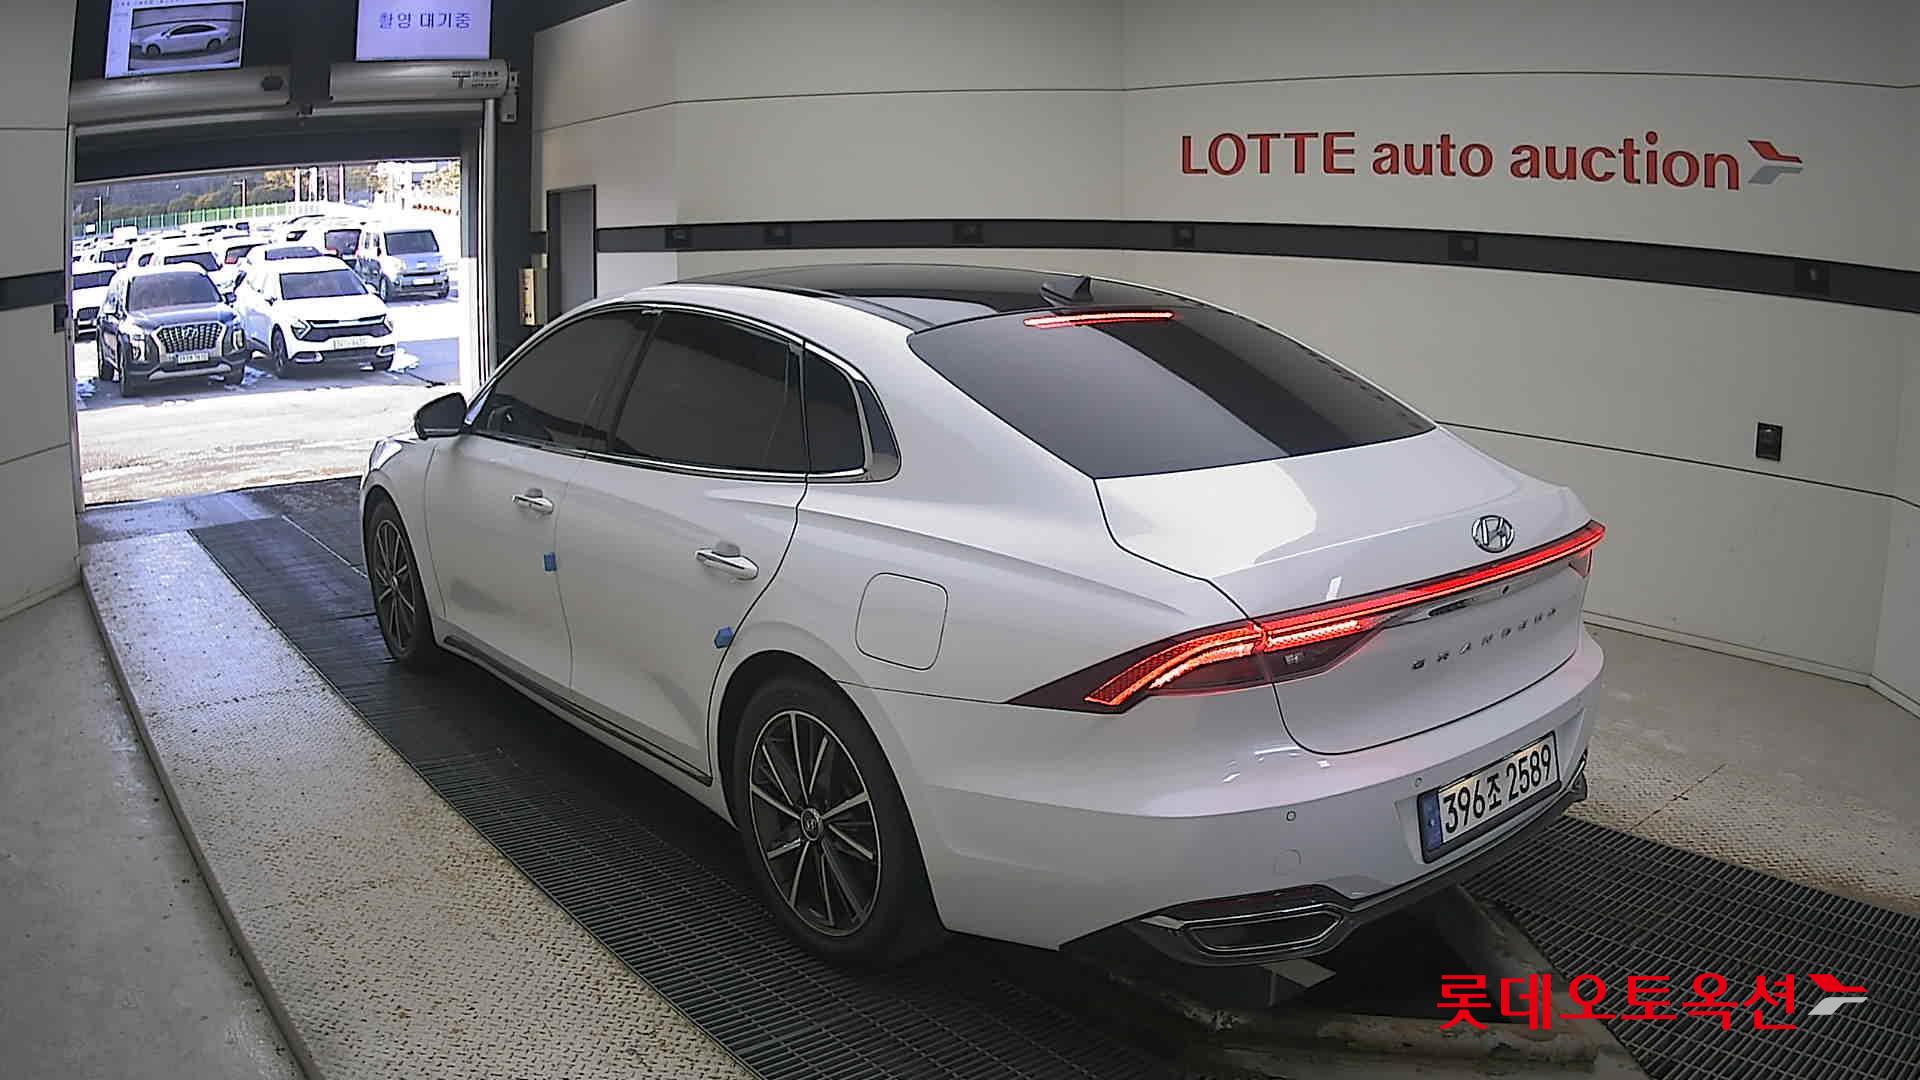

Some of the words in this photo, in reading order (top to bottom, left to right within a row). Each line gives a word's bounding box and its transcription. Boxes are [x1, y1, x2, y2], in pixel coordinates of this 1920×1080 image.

[419, 12, 471, 29] 대기중
[1182, 131, 1356, 176] LOTTE
[1372, 133, 1494, 178] auto
[1510, 130, 1740, 191] auction
[1442, 773, 1502, 834] 396조
[1505, 744, 1552, 802] 2589
